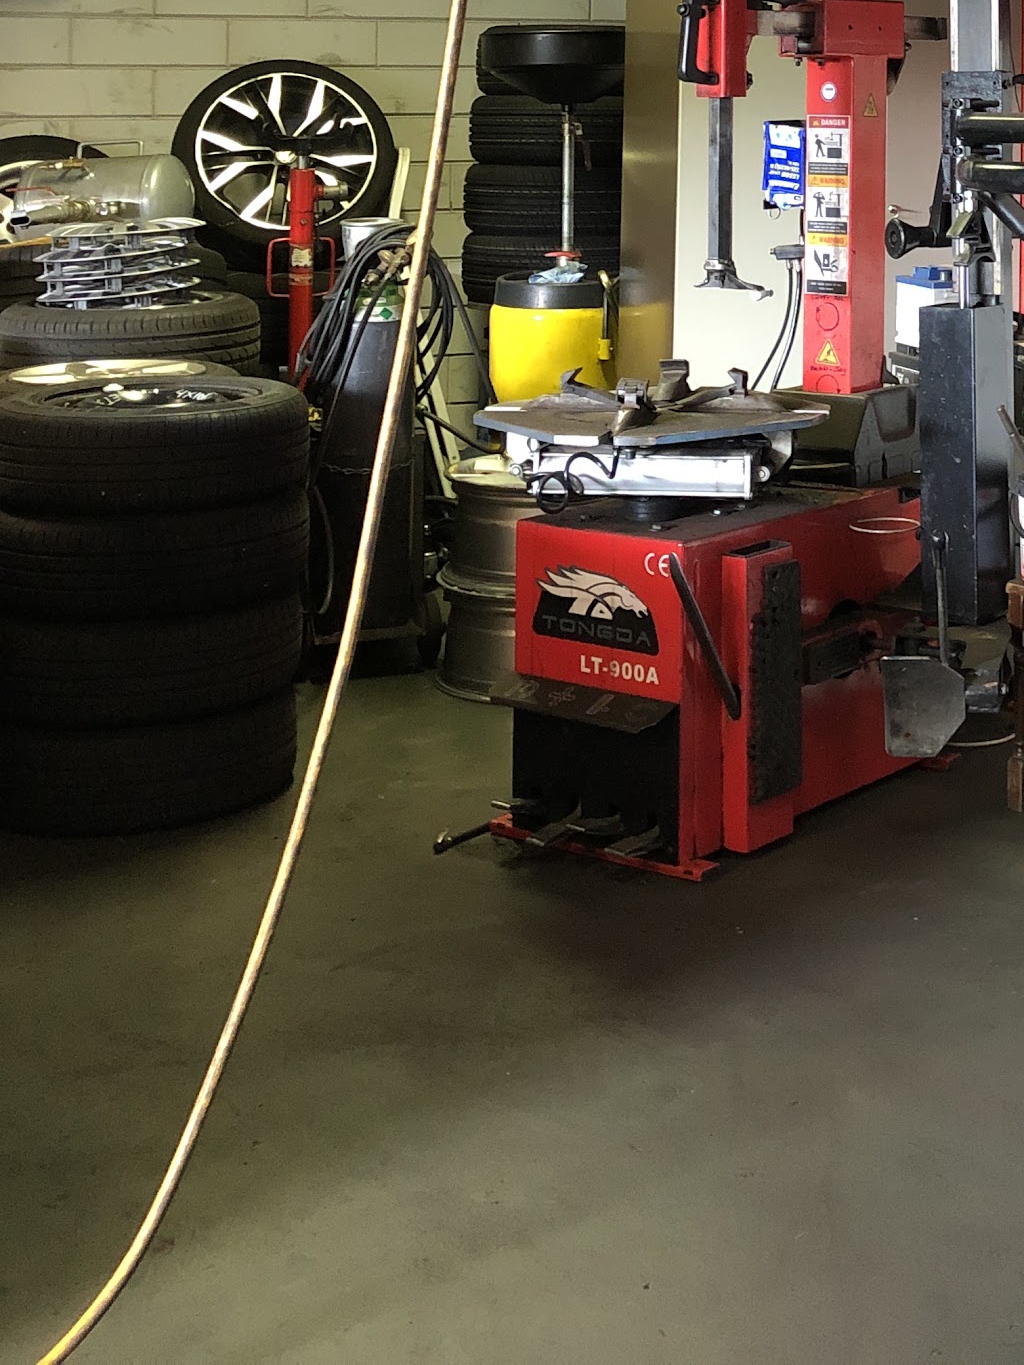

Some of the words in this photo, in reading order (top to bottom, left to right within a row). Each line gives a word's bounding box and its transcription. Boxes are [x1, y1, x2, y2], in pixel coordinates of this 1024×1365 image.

[820, 118, 846, 126] DANGER
[542, 613, 651, 648] TONGDA
[580, 654, 659, 686] LT-900A
